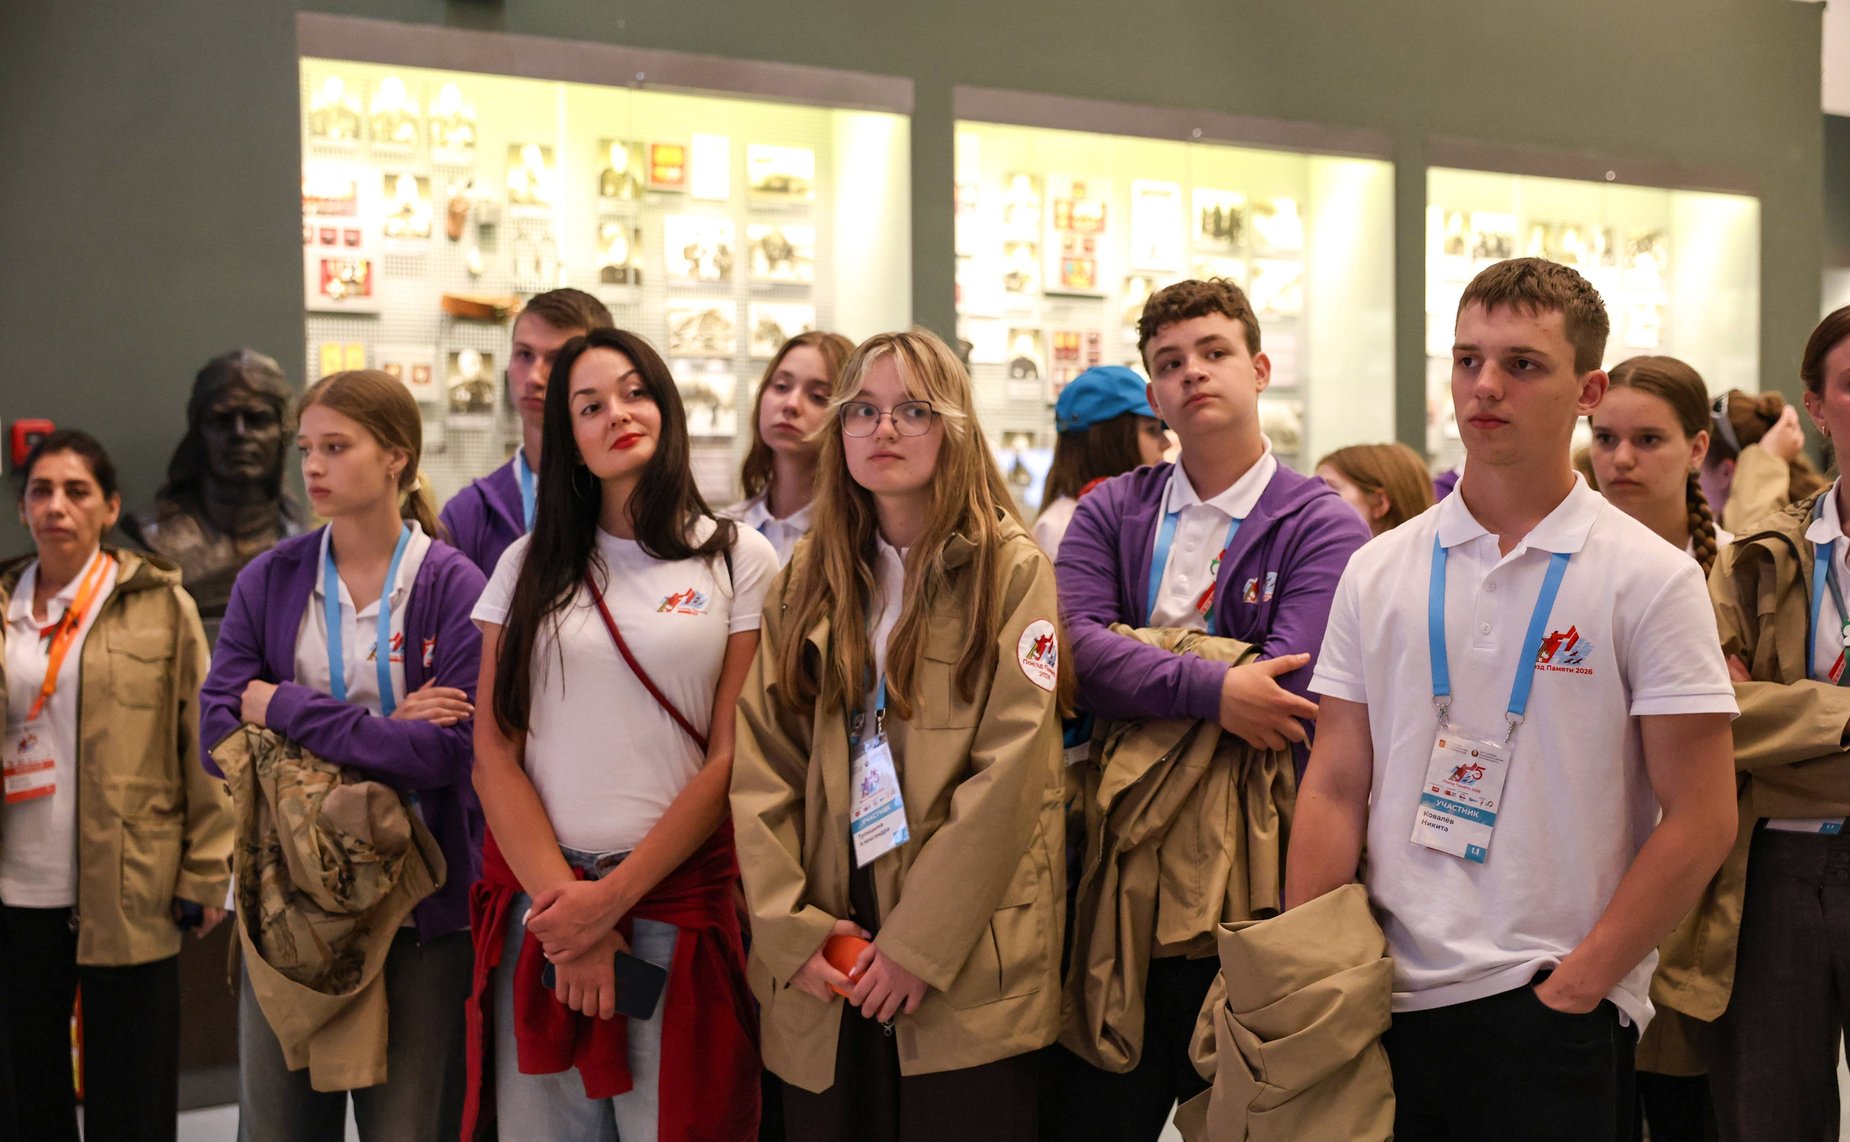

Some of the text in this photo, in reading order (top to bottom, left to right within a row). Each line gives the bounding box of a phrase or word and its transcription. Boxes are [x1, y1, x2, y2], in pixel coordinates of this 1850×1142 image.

[1435, 799, 1480, 818] УЧАСТНИК
[1421, 818, 1449, 832] Никита
[1423, 810, 1454, 825] Ковалёв
